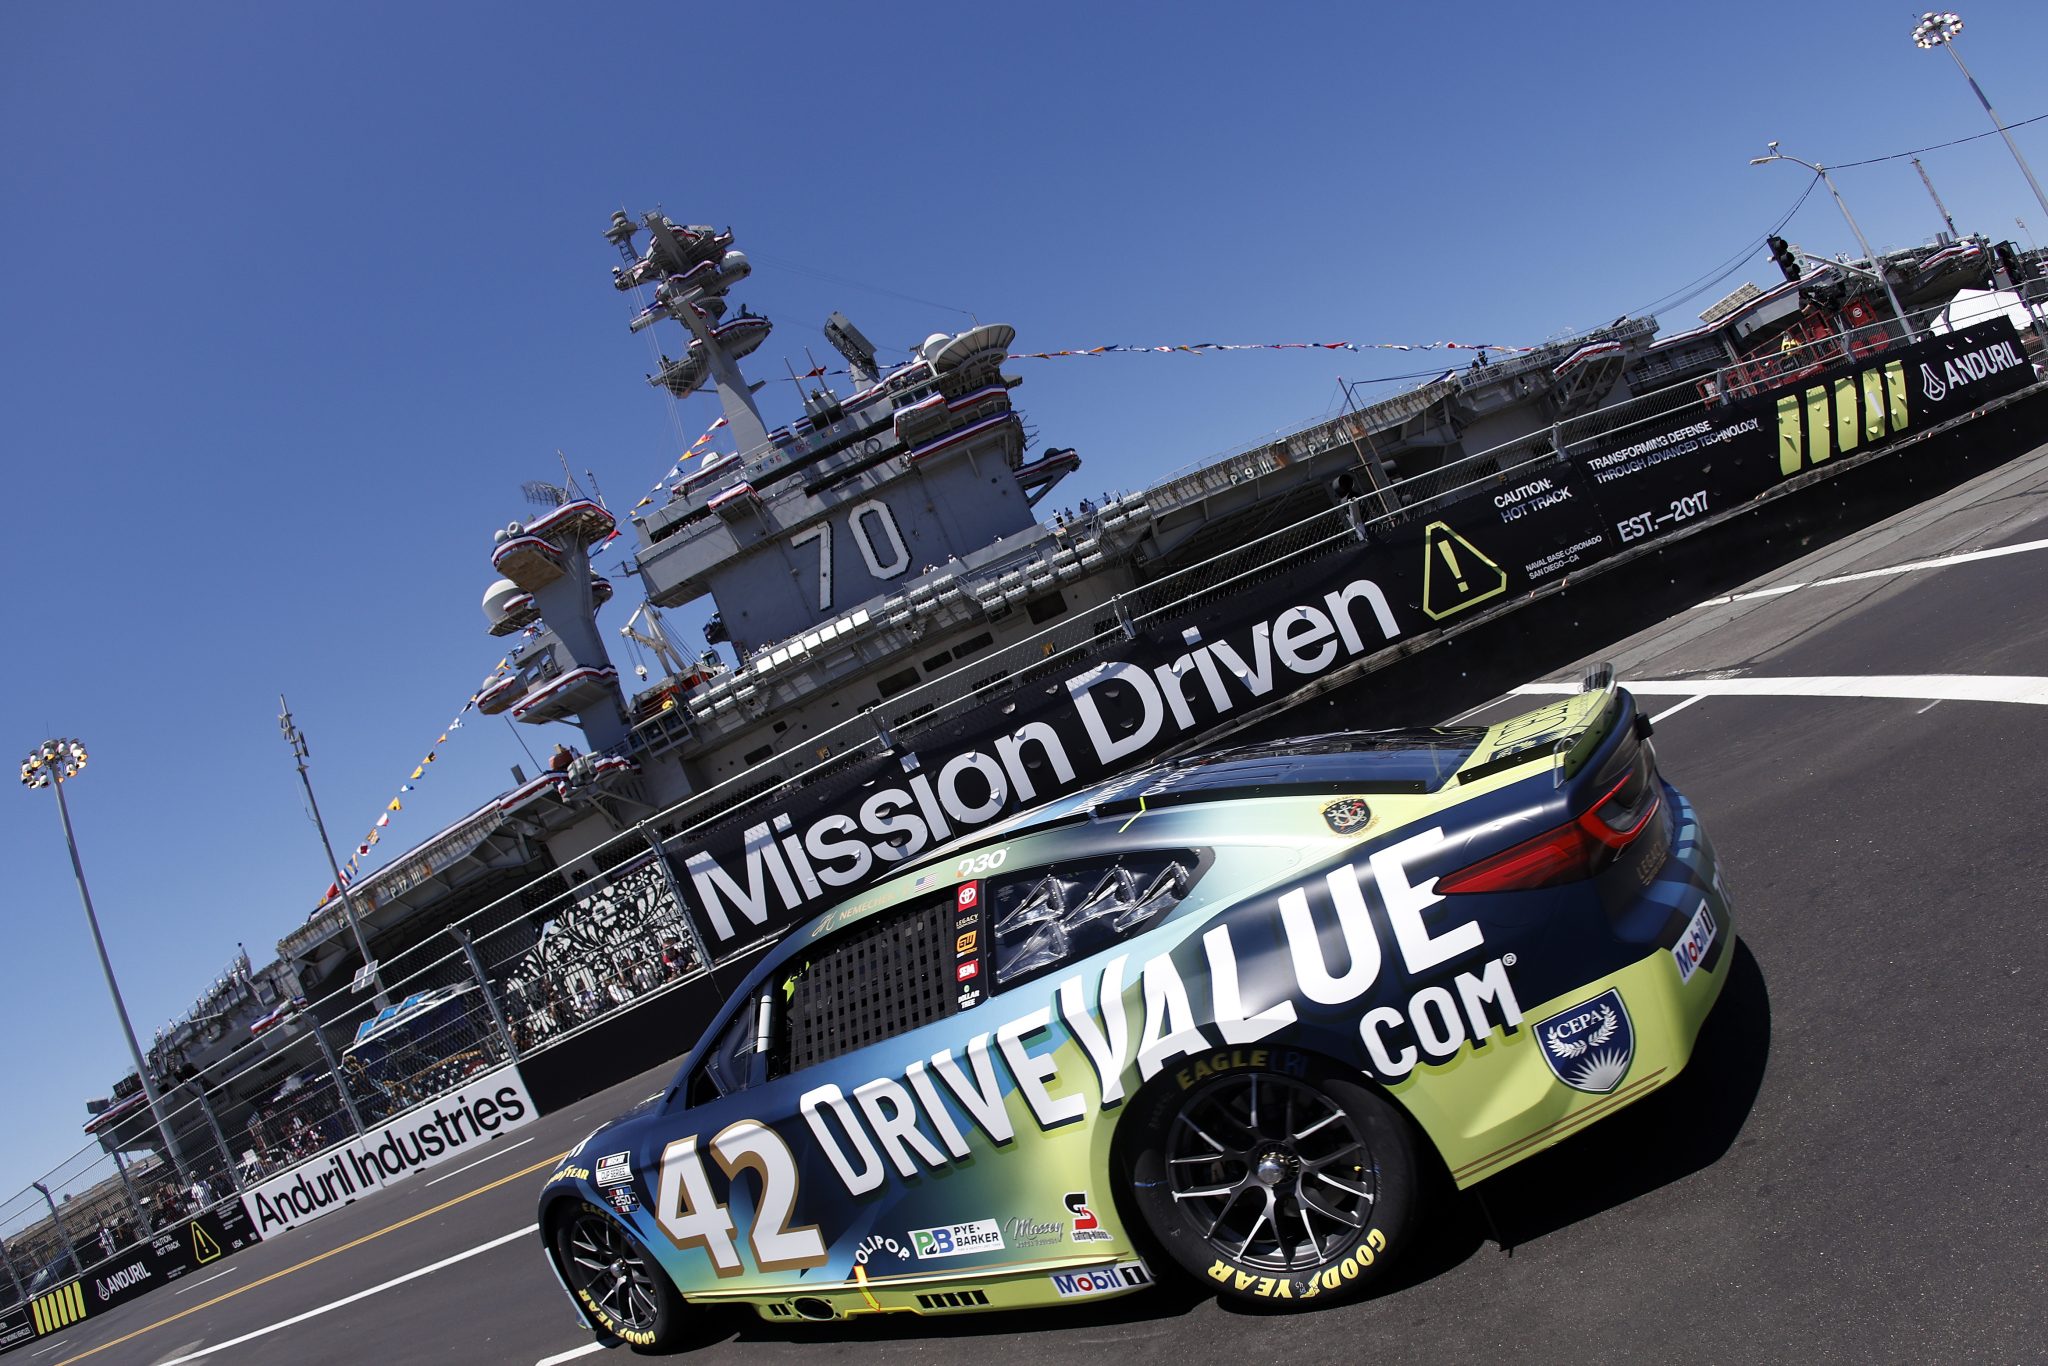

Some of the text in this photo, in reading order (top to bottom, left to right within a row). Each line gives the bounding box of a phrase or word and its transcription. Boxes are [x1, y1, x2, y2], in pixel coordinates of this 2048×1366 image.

[1943, 340, 2023, 390] ANDURIL
[1587, 420, 1712, 471] TRANSFORMING DEFENSE
[1594, 418, 1759, 484] THROUGH ADVANCED TECHNOLOGY
[1494, 477, 1553, 508] CAUTION:
[1501, 486, 1573, 523] HOT TRACK
[790, 499, 913, 612] 70
[1525, 535, 1602, 572] NAVAL BASE CORONADO
[1529, 568, 1545, 580] SAN
[684, 577, 1402, 942] Mission Driven
[1675, 917, 1709, 979] Mobil
[1556, 1010, 1604, 1038] CEPA
[1176, 1049, 1270, 1091] EAGLE
[254, 1086, 525, 1233] Anduril Industries
[614, 1194, 632, 1206] 250
[656, 1119, 829, 1279] 42
[231, 1239, 244, 1249] USA
[914, 1228, 955, 1256] PB
[956, 1232, 999, 1247] BARKER
[1004, 1216, 1064, 1243] Massey
[107, 1261, 152, 1295] ANDURIL
[1052, 1269, 1121, 1294] Mobil
[1207, 1228, 1387, 1299] GOODYEAR
[578, 1288, 656, 1345] GOODYEAR
